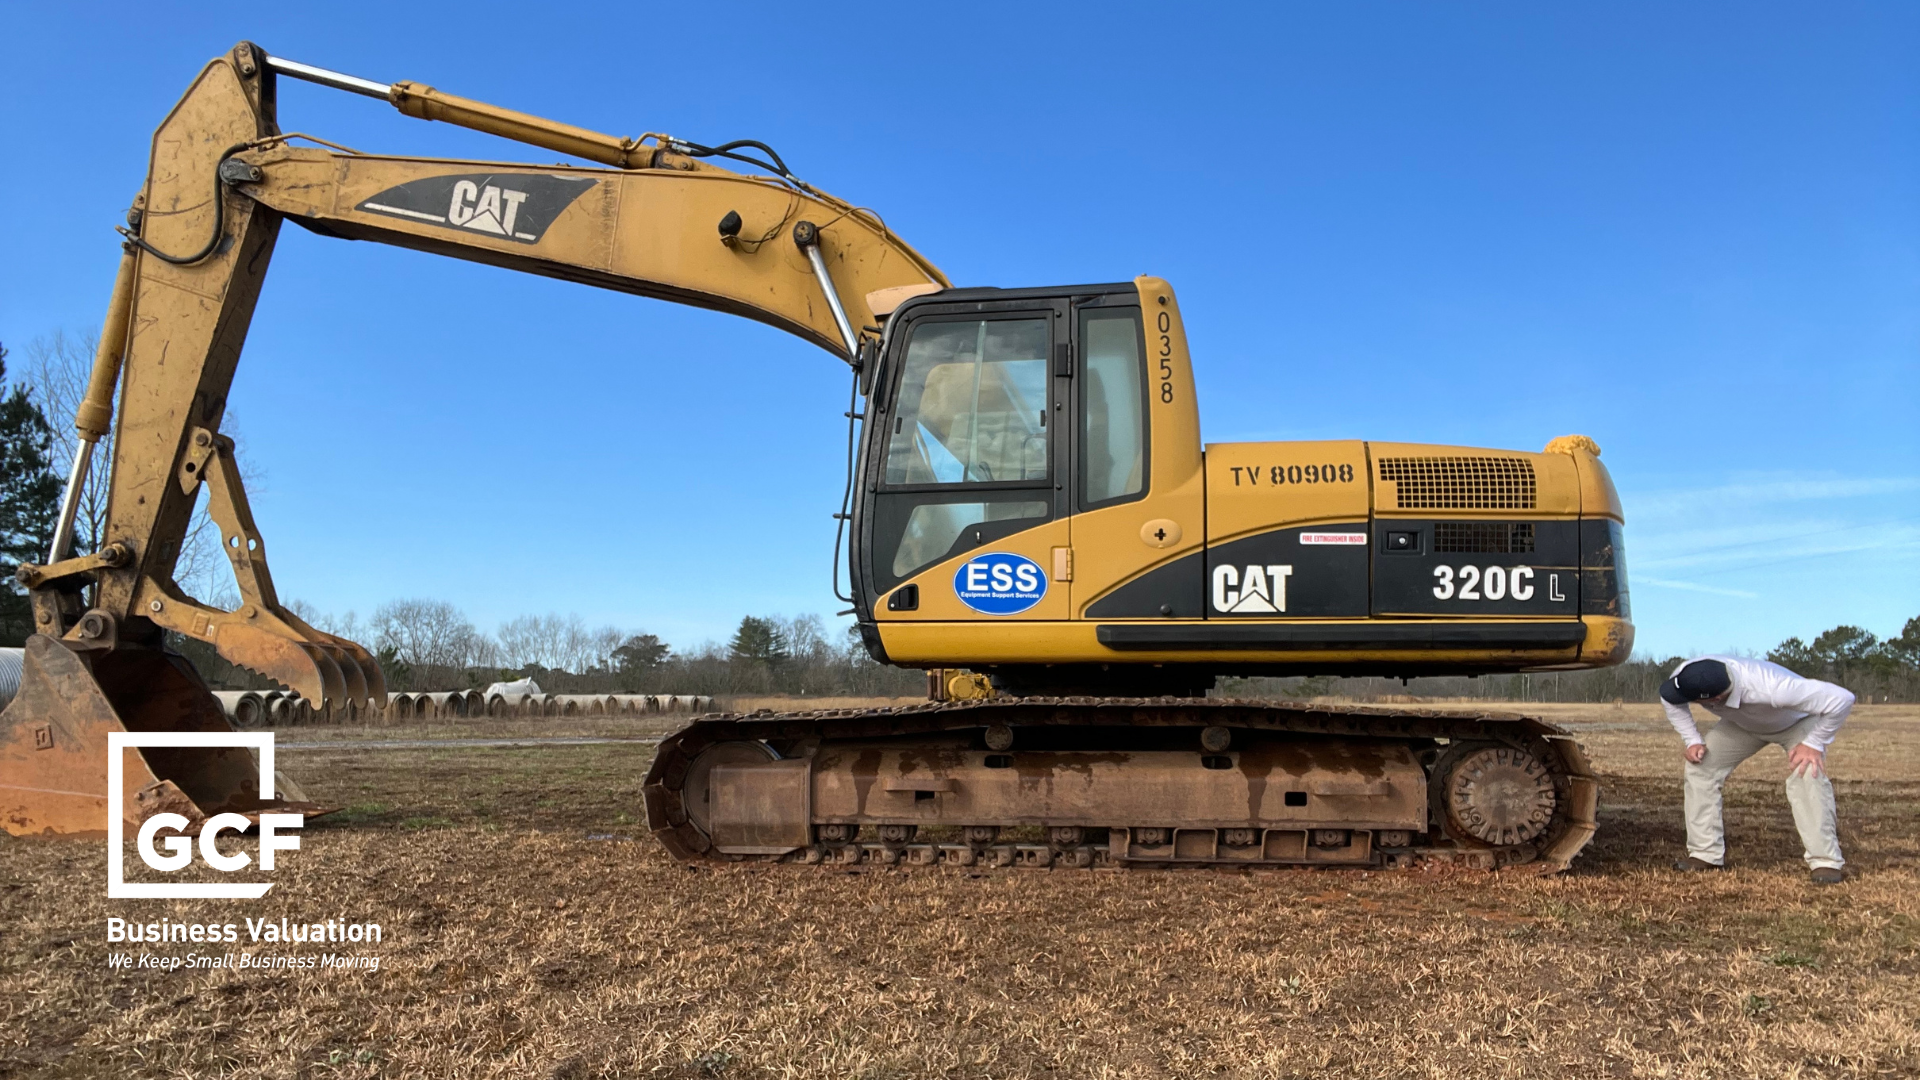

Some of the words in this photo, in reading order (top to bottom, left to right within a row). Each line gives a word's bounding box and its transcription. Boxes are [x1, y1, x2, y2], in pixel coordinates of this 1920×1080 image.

[449, 180, 526, 236] CAT
[1230, 466, 1260, 486] TV
[1271, 463, 1354, 485] 80908
[967, 563, 1038, 592] ESS
[1213, 564, 1293, 613] CAT
[1433, 565, 1534, 600] 320C
[1550, 573, 1565, 601] L
